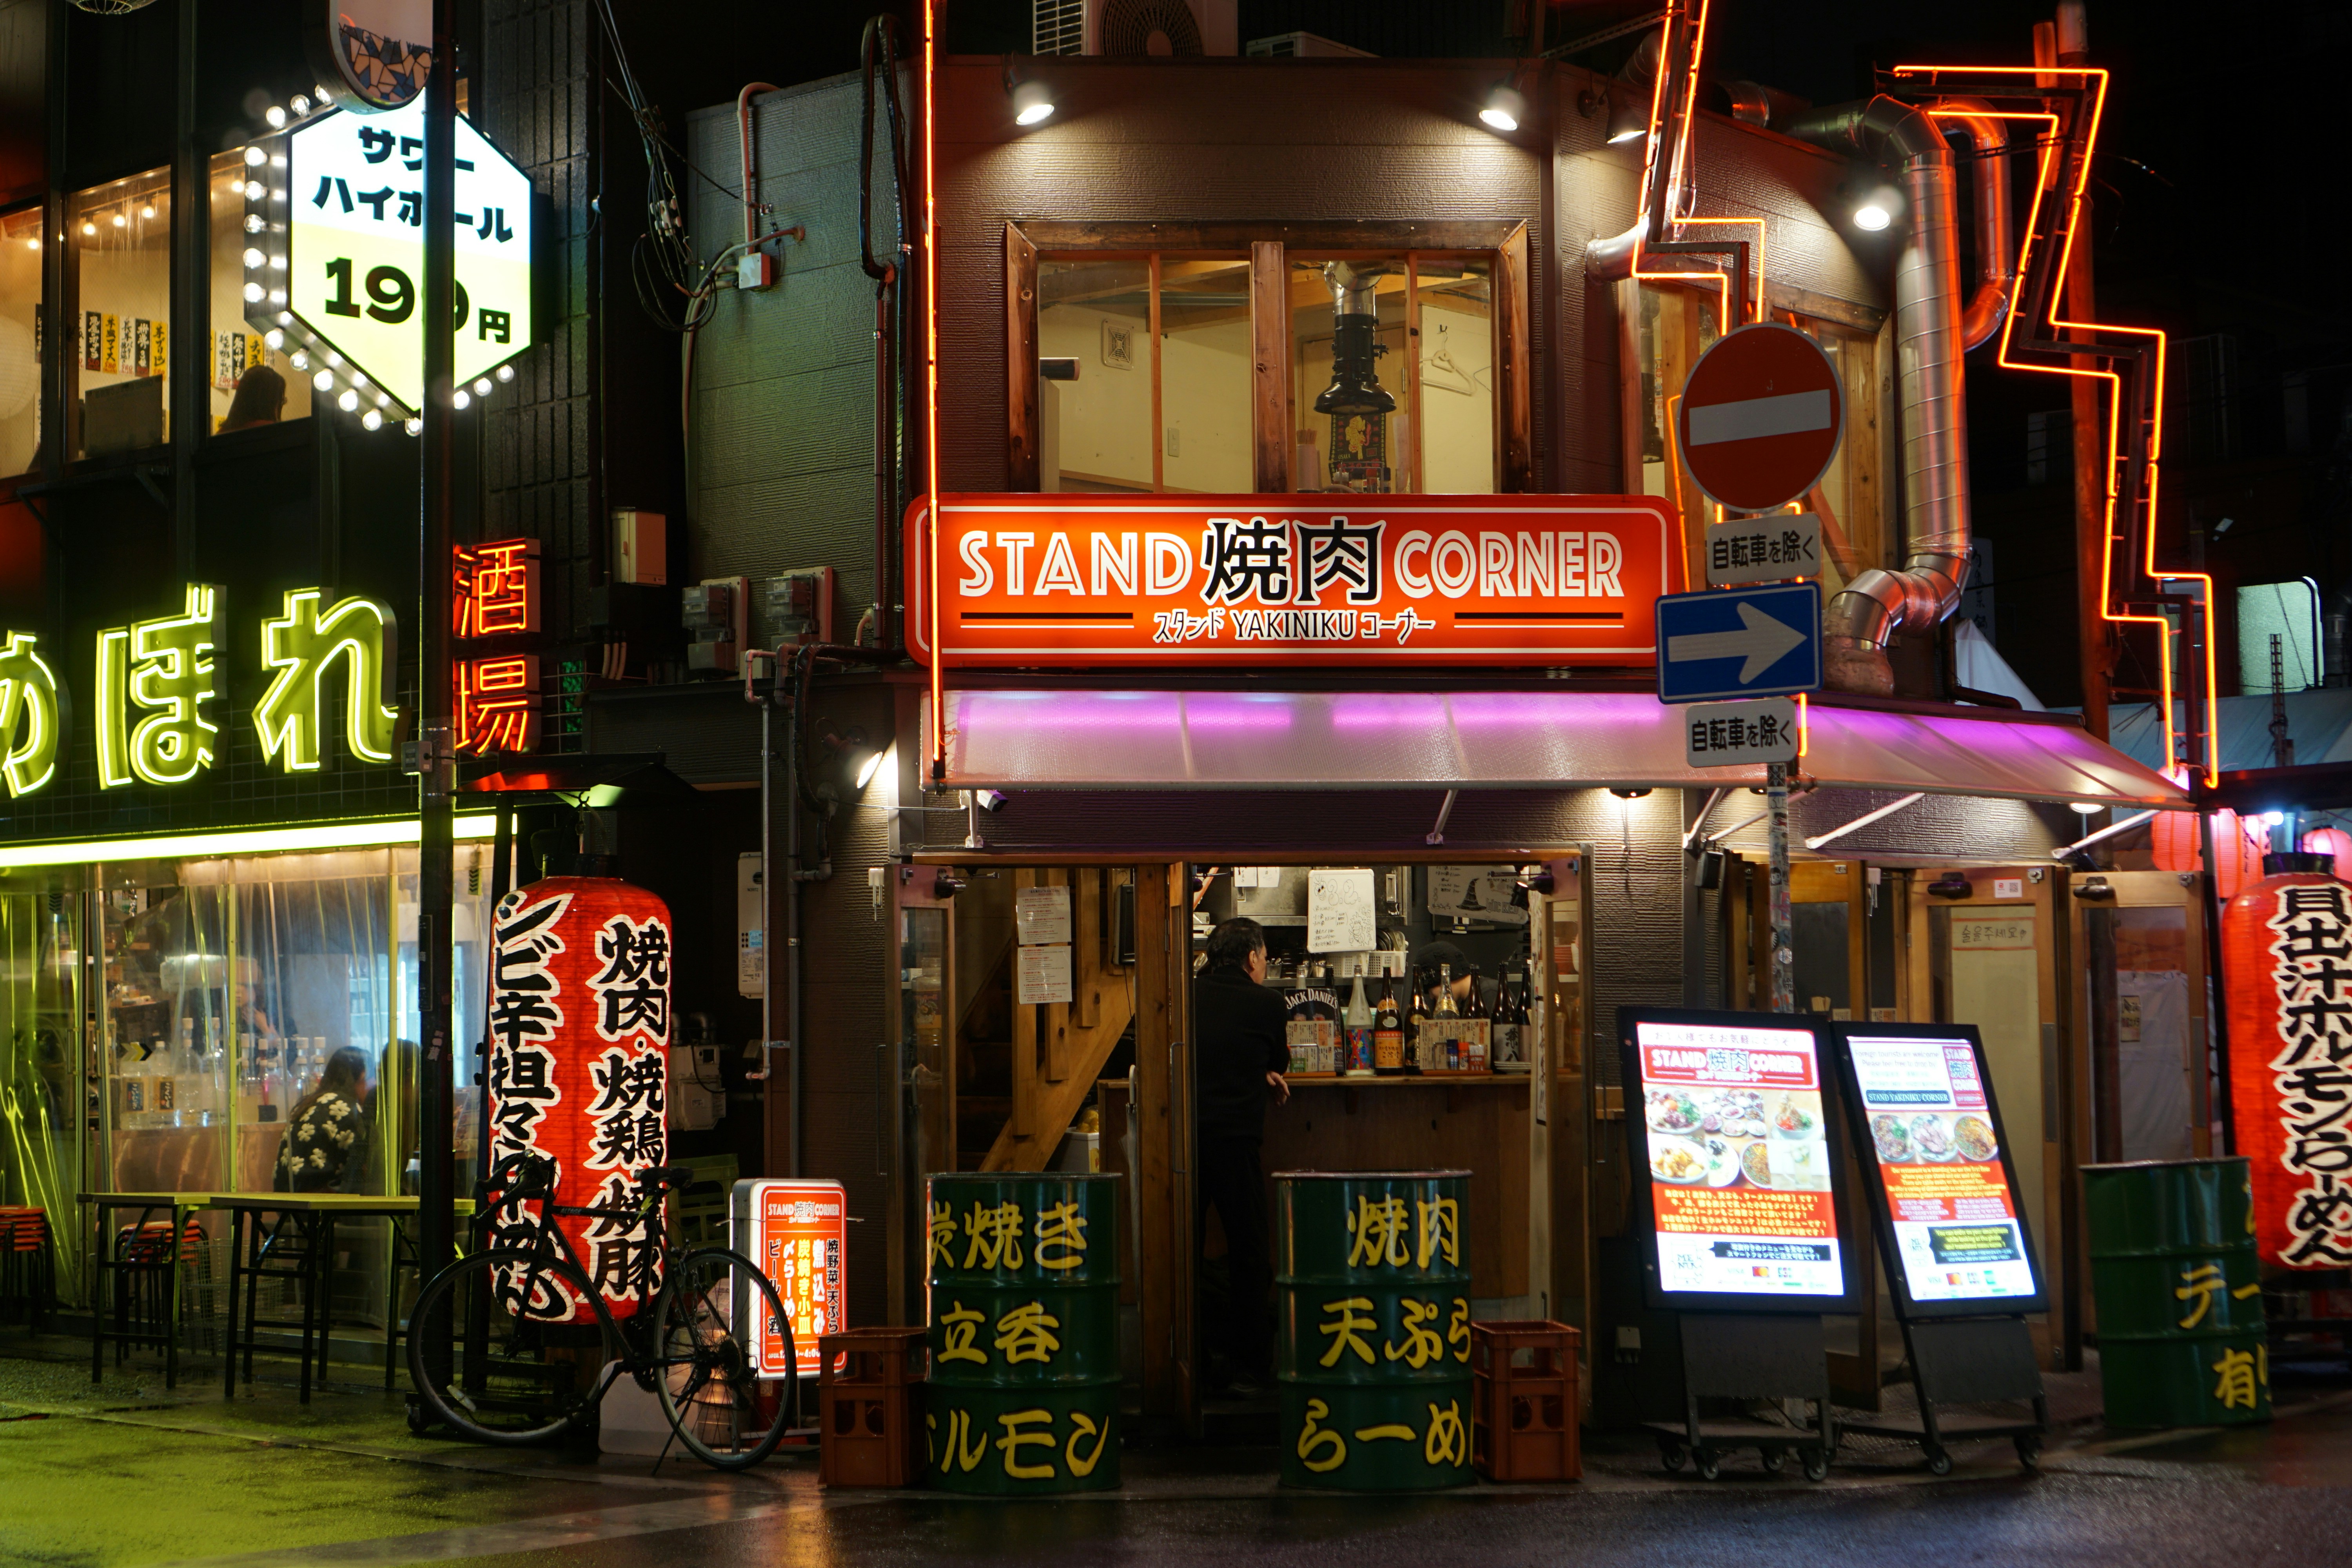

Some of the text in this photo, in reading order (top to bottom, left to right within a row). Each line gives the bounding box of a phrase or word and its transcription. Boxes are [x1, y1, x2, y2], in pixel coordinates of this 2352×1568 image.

[959, 517, 1625, 604] STAND 焼肉 CORNER
[1713, 530, 1814, 570] 自転車を除く
[1154, 607, 1436, 645] スタンド YAKINIKU コーナー
[1691, 714, 1791, 752] 自転車を除く
[1285, 988, 1339, 1010] JACK DANIEL'S
[1651, 1048, 1803, 1073] STAND 焼肉 CORNER
[1868, 1093, 1890, 1101] STAND
[1890, 1093, 1921, 1102] YAKINIKU
[1922, 1093, 1949, 1102] CORNER
[768, 1201, 840, 1217] STAND 焼肉 CORNER
[1347, 1193, 1459, 1269] 焼肉
[783, 1239, 796, 1335] 〆らーめ
[797, 1238, 811, 1336] 炭焼き小皿
[812, 1238, 826, 1334] 煮込み
[826, 1238, 840, 1334] 焼野菜・天ぷら
[937, 1300, 1061, 1365] 立呑
[1319, 1297, 1472, 1369] 天ぷら
[928, 1409, 1109, 1479] ルモン
[1297, 1398, 1474, 1473] らーめ
